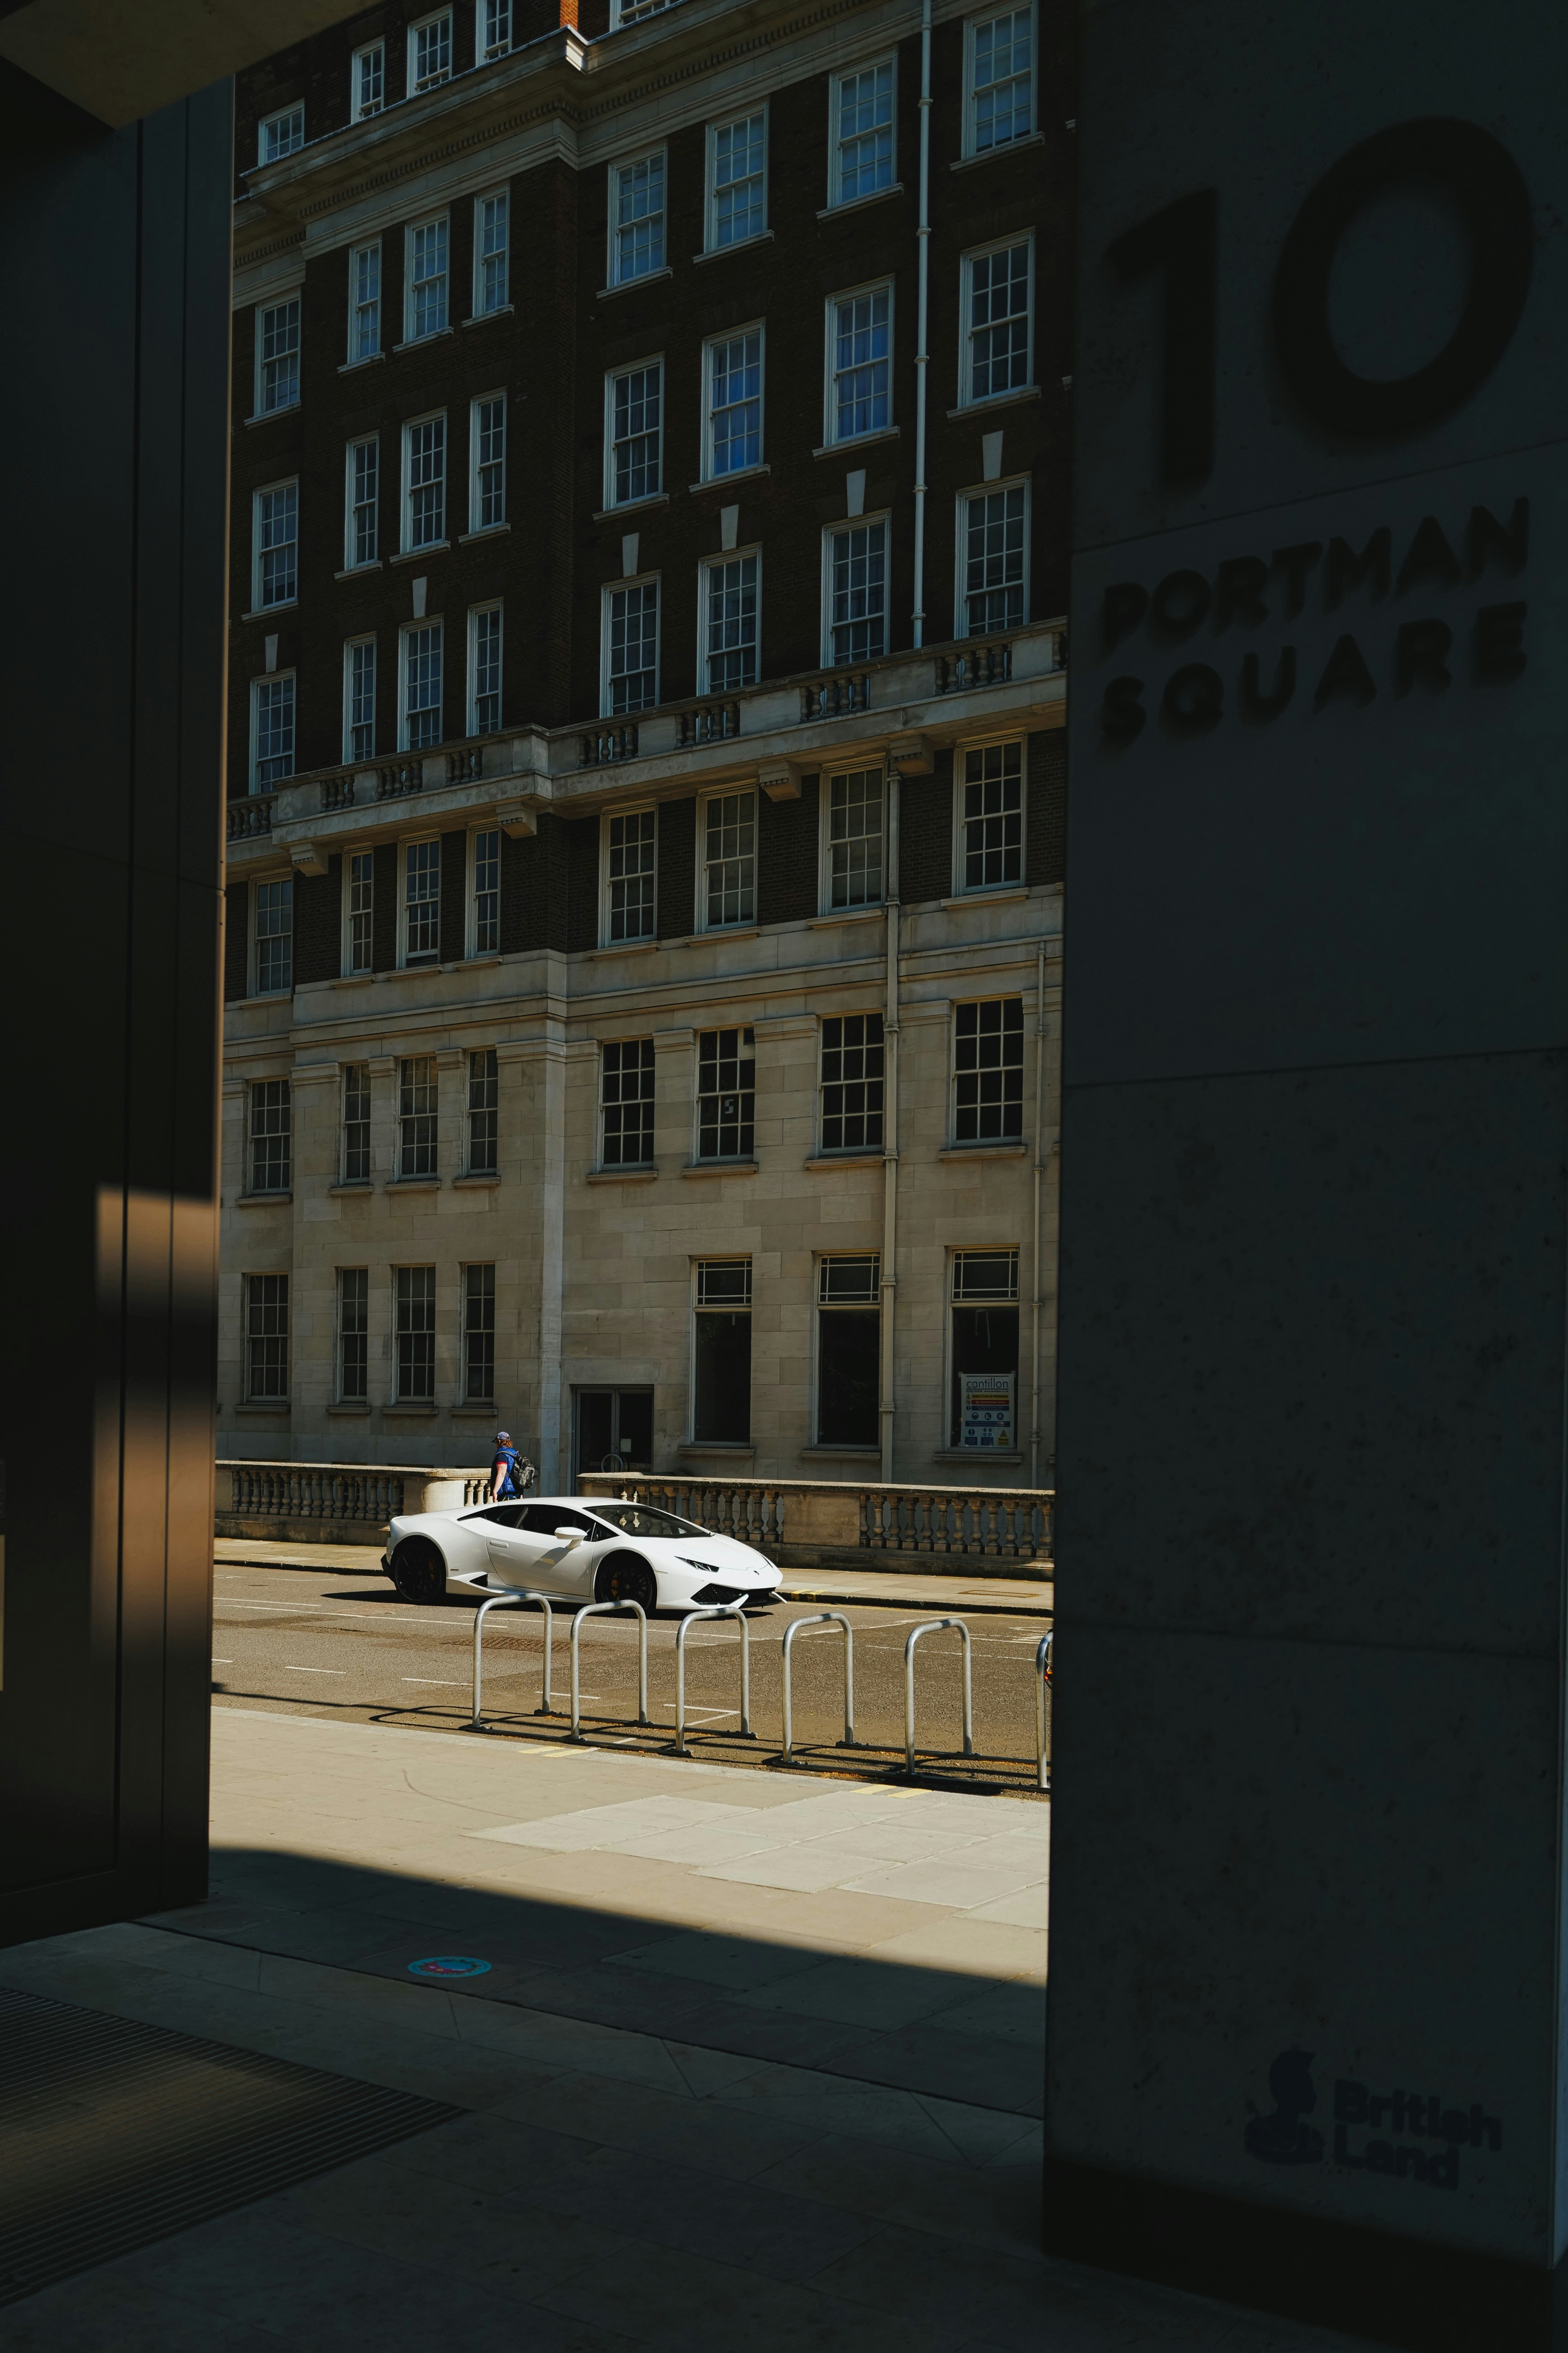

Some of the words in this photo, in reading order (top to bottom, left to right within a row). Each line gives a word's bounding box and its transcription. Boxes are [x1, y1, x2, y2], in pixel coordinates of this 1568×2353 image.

[1105, 115, 1534, 494] 10
[1102, 496, 1530, 654] PORTMAN
[1101, 601, 1528, 743] SQUARE
[967, 1377, 1008, 1388] cantillon
[1334, 2079, 1502, 2151] British
[1334, 2123, 1459, 2191] Land
